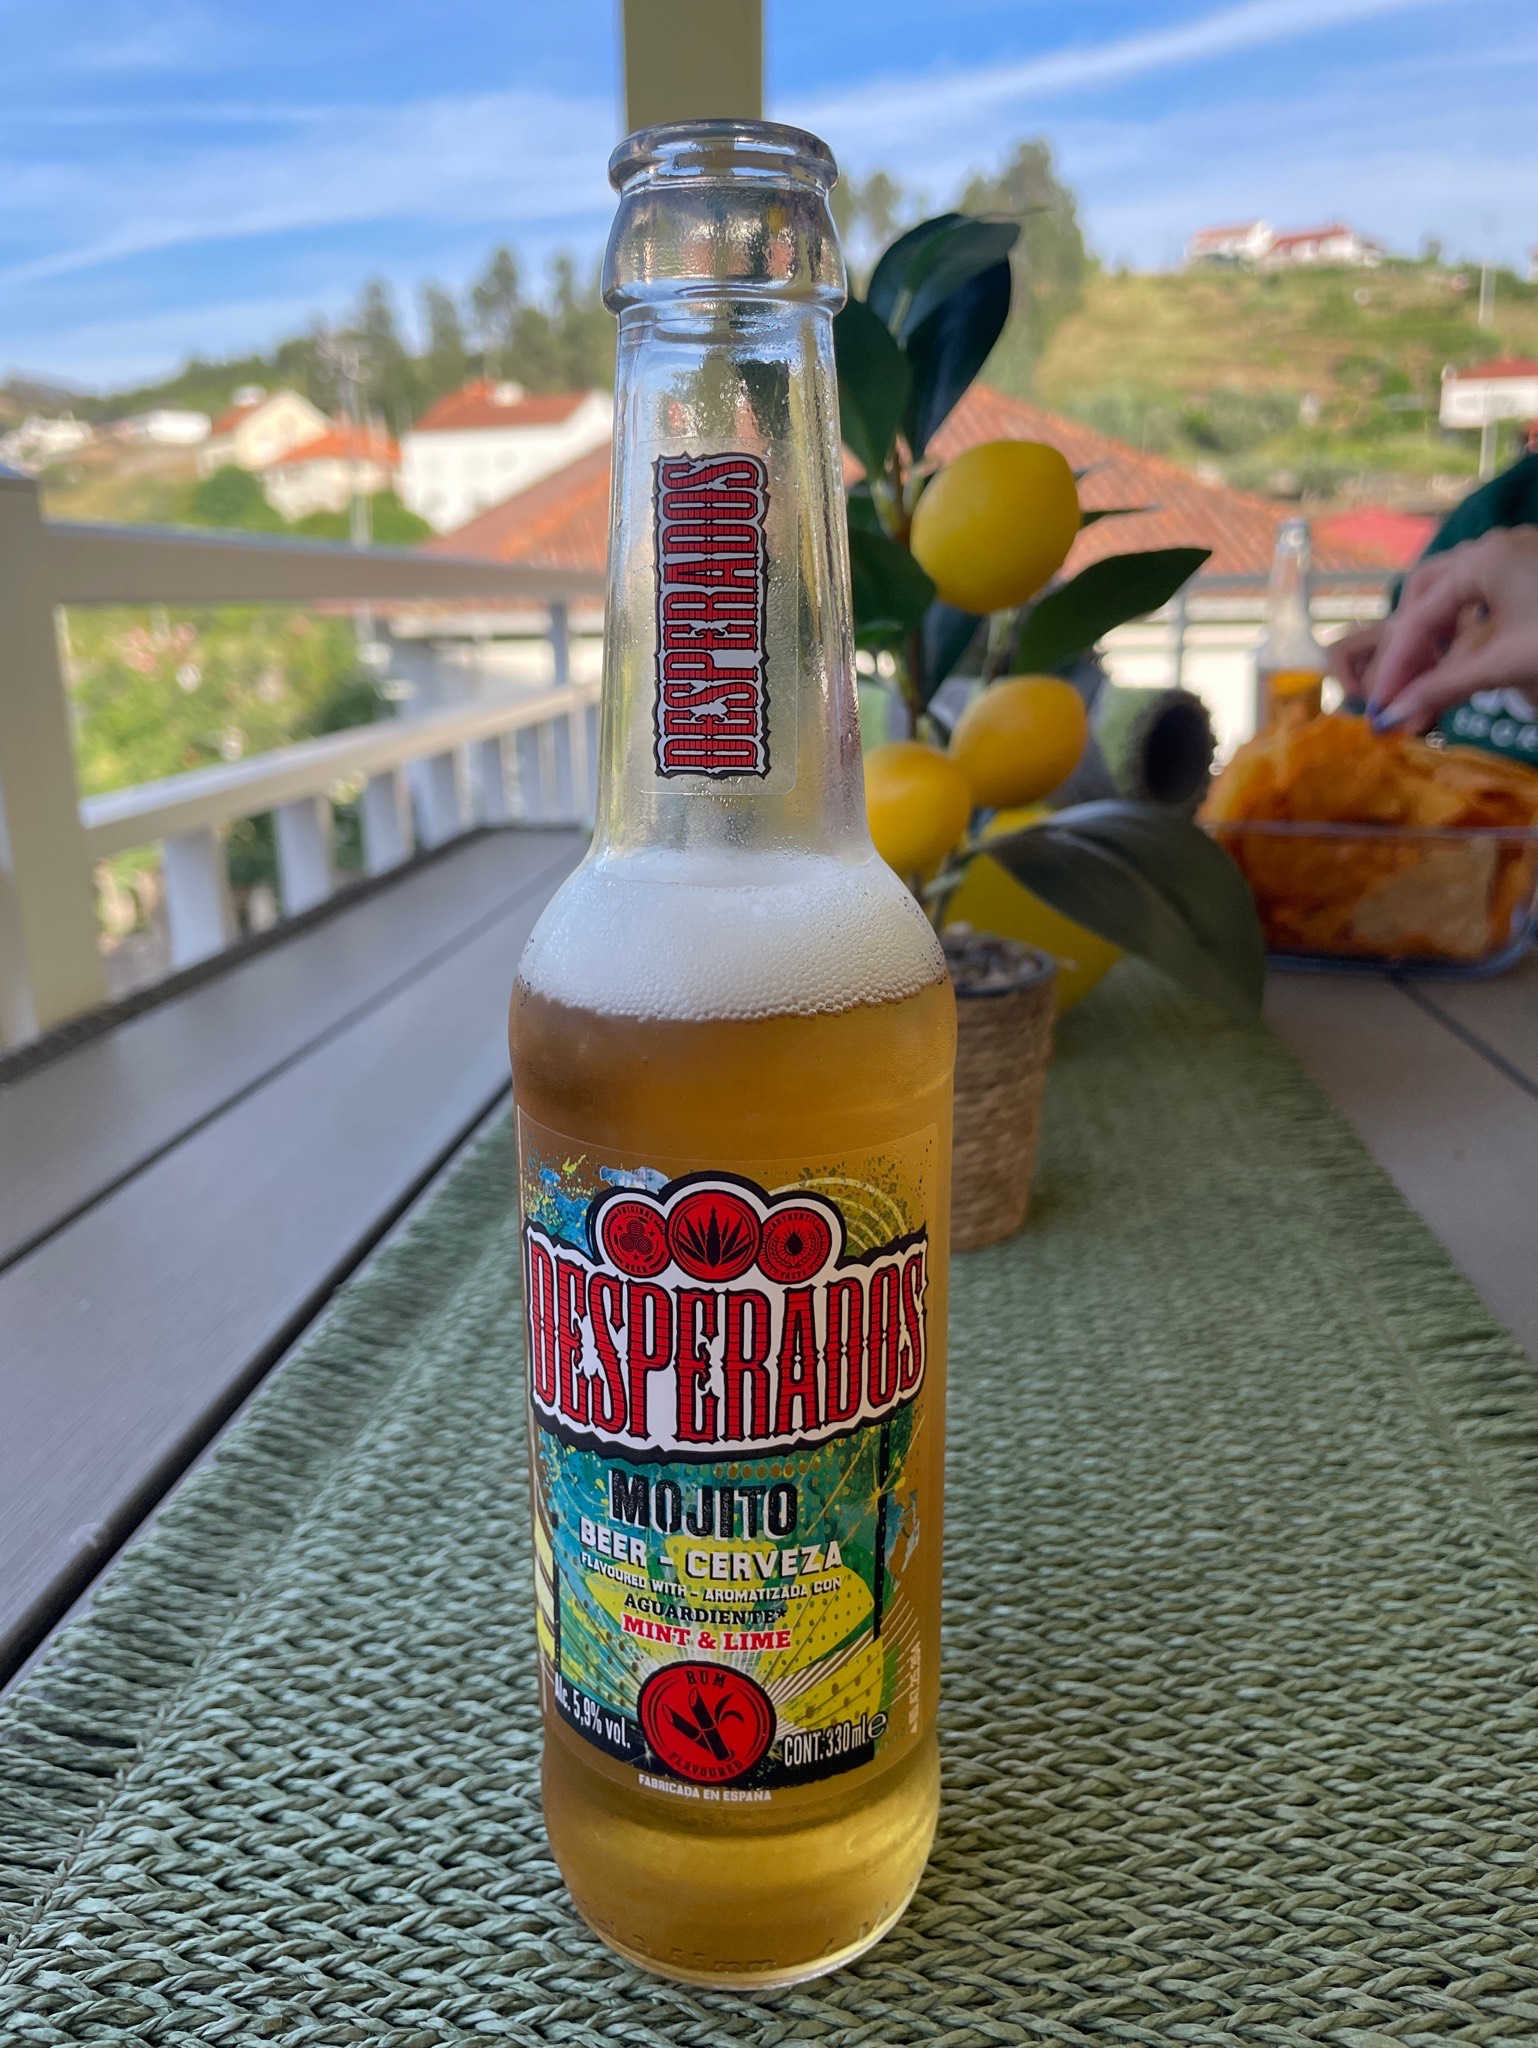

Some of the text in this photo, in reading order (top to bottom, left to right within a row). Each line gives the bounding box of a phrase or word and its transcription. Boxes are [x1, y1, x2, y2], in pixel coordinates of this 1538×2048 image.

[662, 459, 760, 768] DESPERADOS
[530, 1240, 927, 1443] DESPERADOS
[608, 1466, 798, 1542] MOJITO
[580, 1516, 647, 1569] BEER
[686, 1540, 842, 1581] CERVEZA
[580, 1552, 648, 1589] FLAVOURED
[650, 1579, 687, 1599] WITH
[702, 1583, 808, 1604] AROMATIZADA
[811, 1576, 842, 1595] CON
[622, 1613, 792, 1651] MINT & LIME
[685, 1670, 728, 1688] RUM
[554, 1671, 571, 1712] Alc.
[605, 1716, 631, 1749] vol.
[638, 1773, 772, 1802] FABRICADA EN ESPAÑA
[667, 1751, 744, 1778] FLAVOURED
